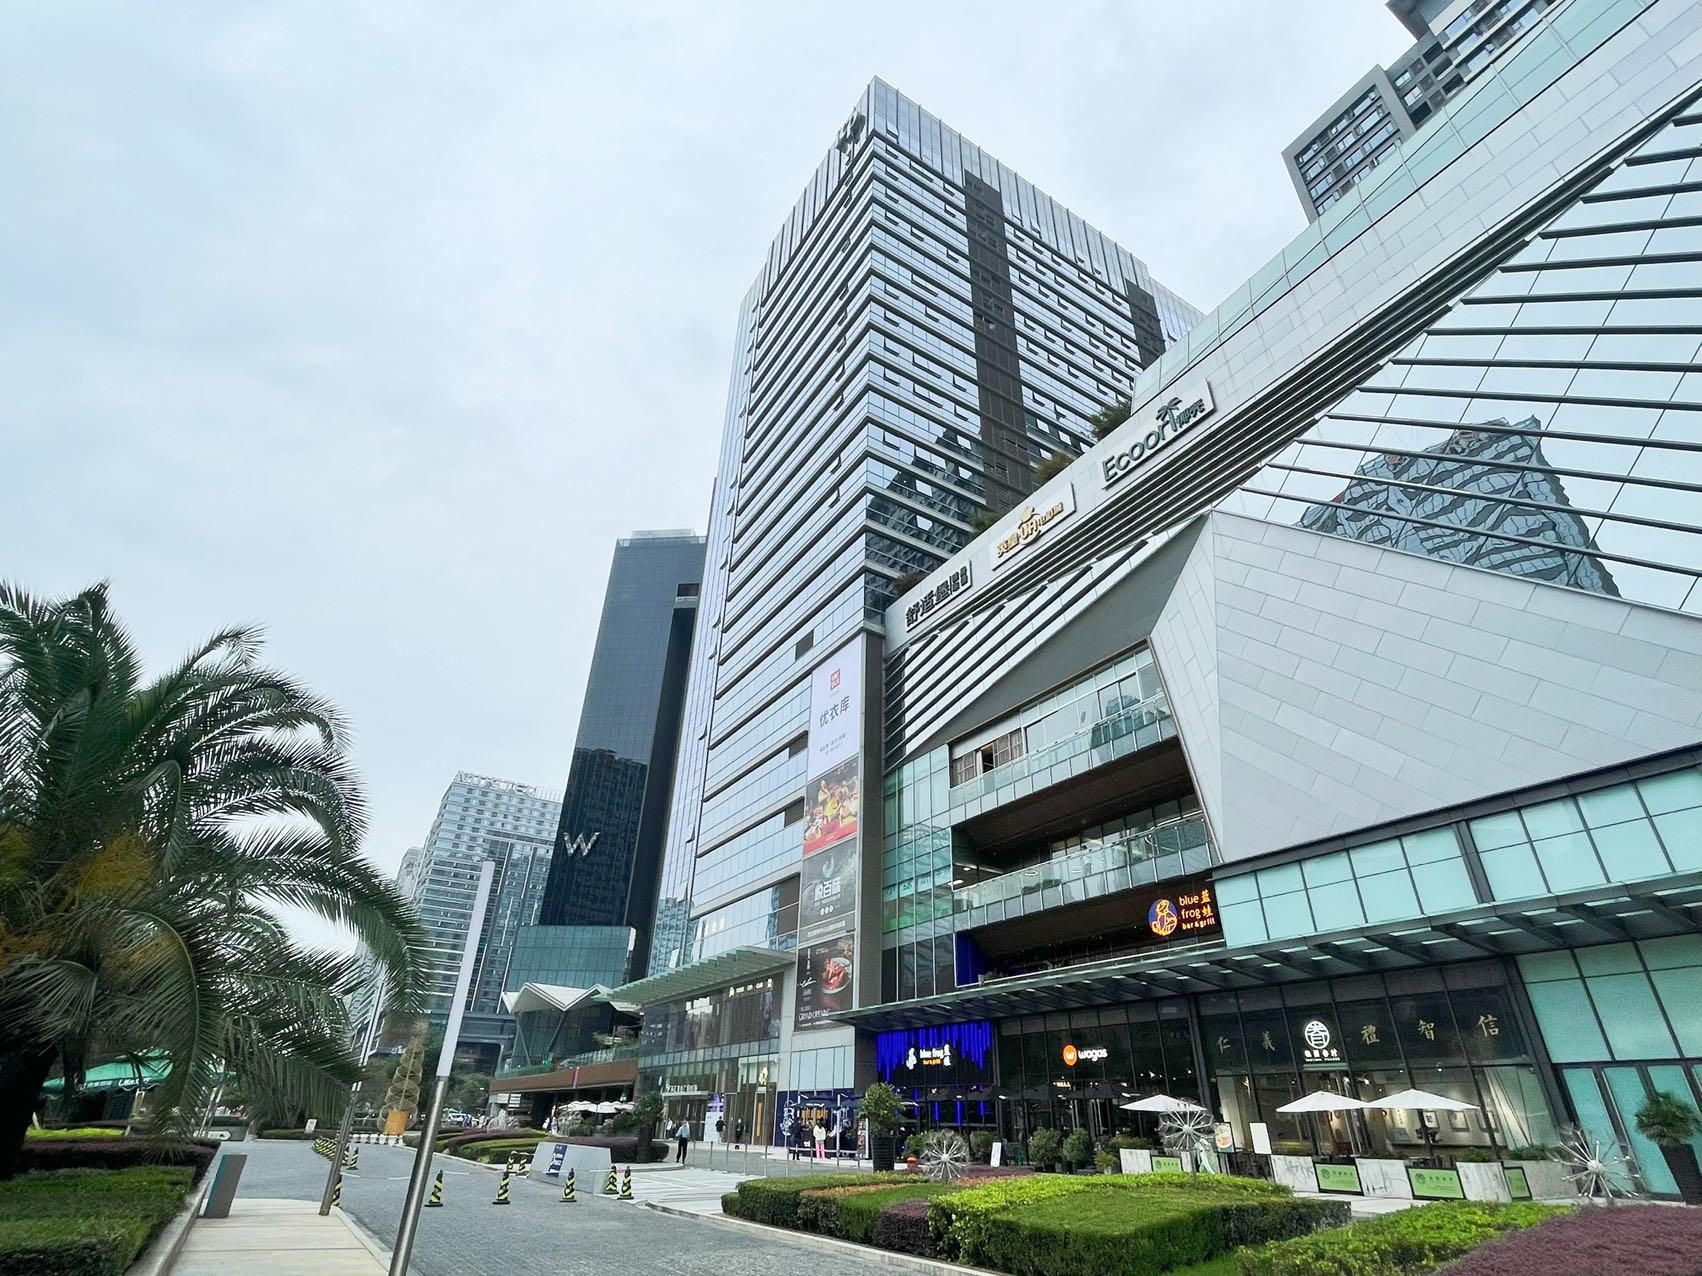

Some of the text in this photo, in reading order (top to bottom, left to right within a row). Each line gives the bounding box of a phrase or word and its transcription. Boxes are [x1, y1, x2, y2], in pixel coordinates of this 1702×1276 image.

[905, 580, 950, 627] 舒适堡
[819, 695, 850, 728] 优衣库
[563, 832, 600, 857] W
[1178, 895, 1200, 906] blue
[1181, 908, 1202, 920] frog
[1182, 922, 1194, 930] bar
[1200, 917, 1216, 928] grill
[1216, 1035, 1231, 1054] 仁
[1360, 1023, 1381, 1046] 禮
[1417, 1019, 1435, 1041] 智
[1476, 1014, 1500, 1038] 信
